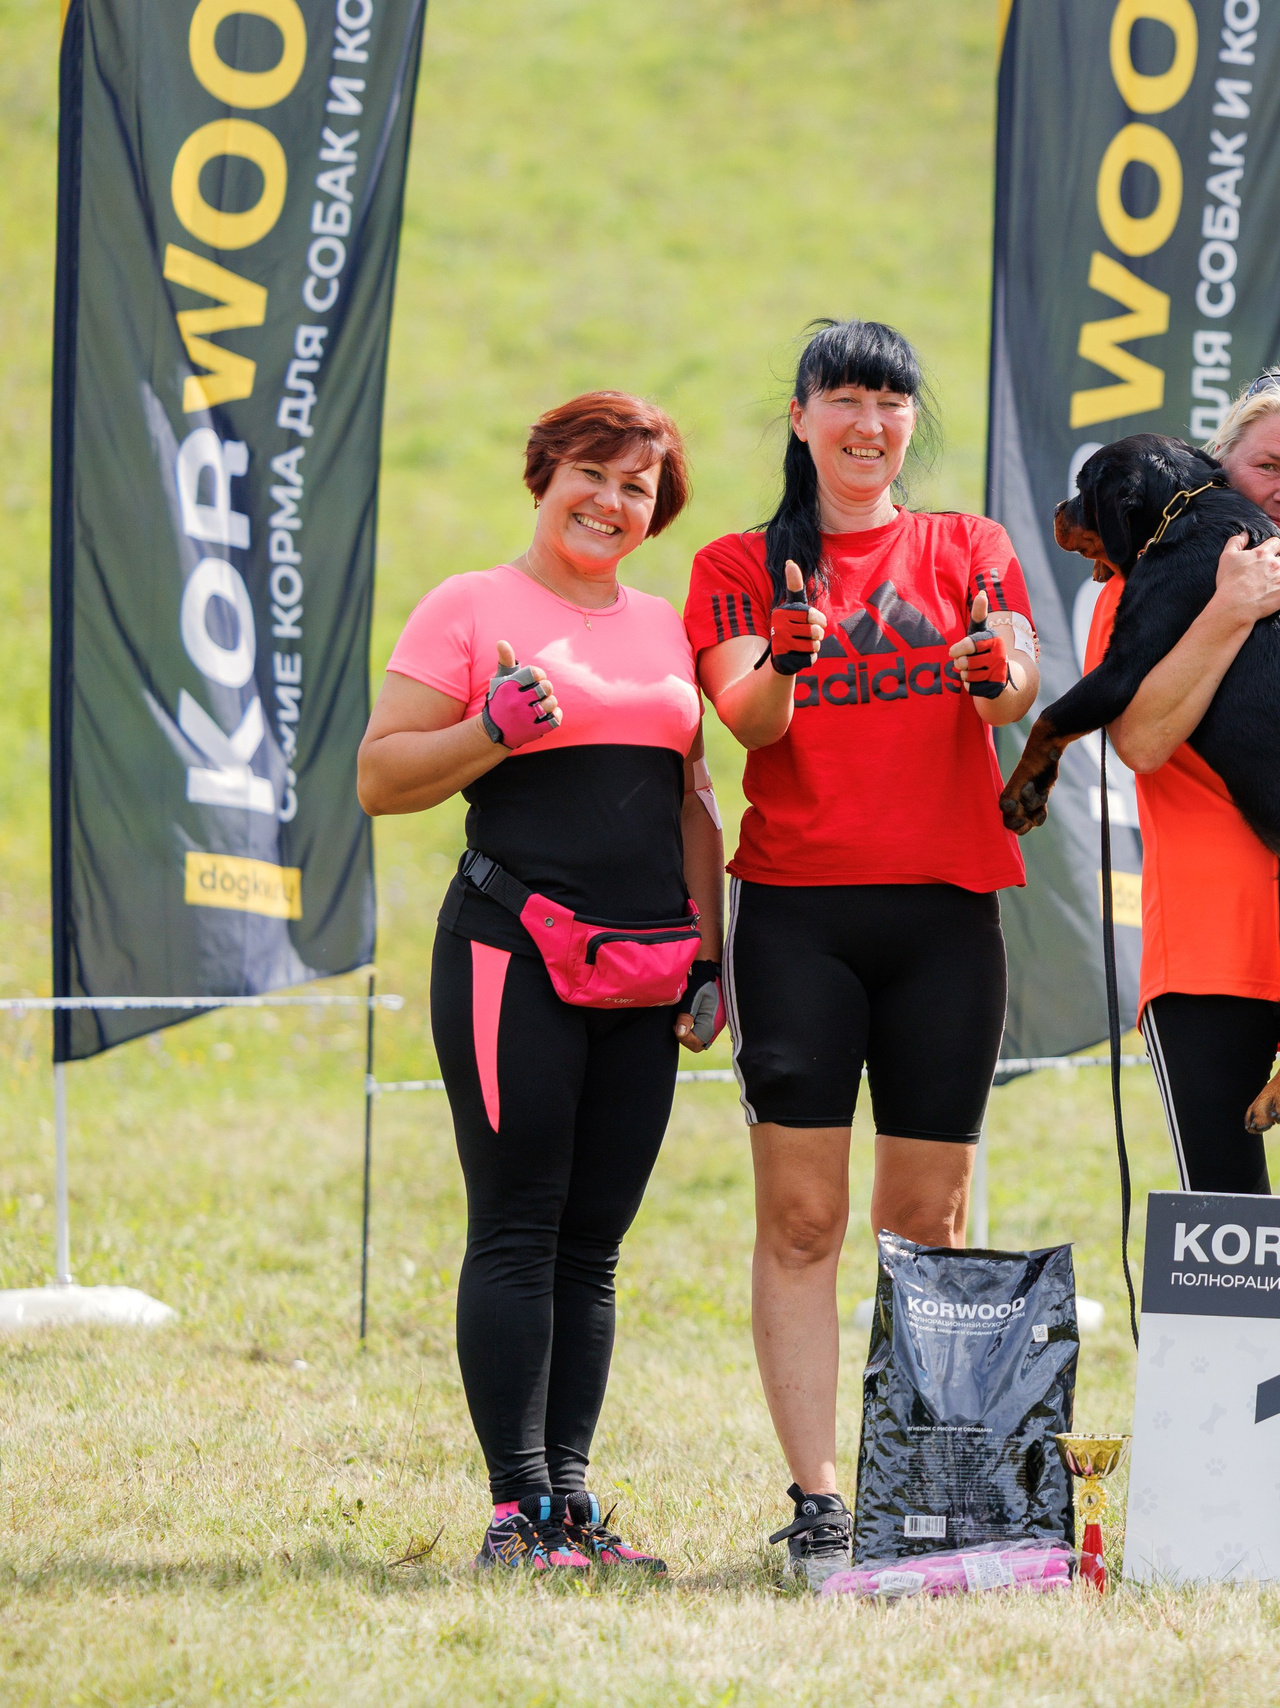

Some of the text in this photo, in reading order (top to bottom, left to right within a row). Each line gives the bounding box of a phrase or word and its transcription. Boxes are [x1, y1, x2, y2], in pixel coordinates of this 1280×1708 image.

[326, 76, 367, 117] И
[1213, 79, 1253, 119] И
[303, 127, 360, 313] СОБАК
[1195, 129, 1248, 318] СОБАК
[276, 324, 328, 437] ДЛЯ
[1190, 330, 1232, 440] ДЛЯ
[268, 446, 306, 638] КОРМА
[794, 656, 961, 709] adidas
[907, 1296, 1026, 1320] KORWOOD
